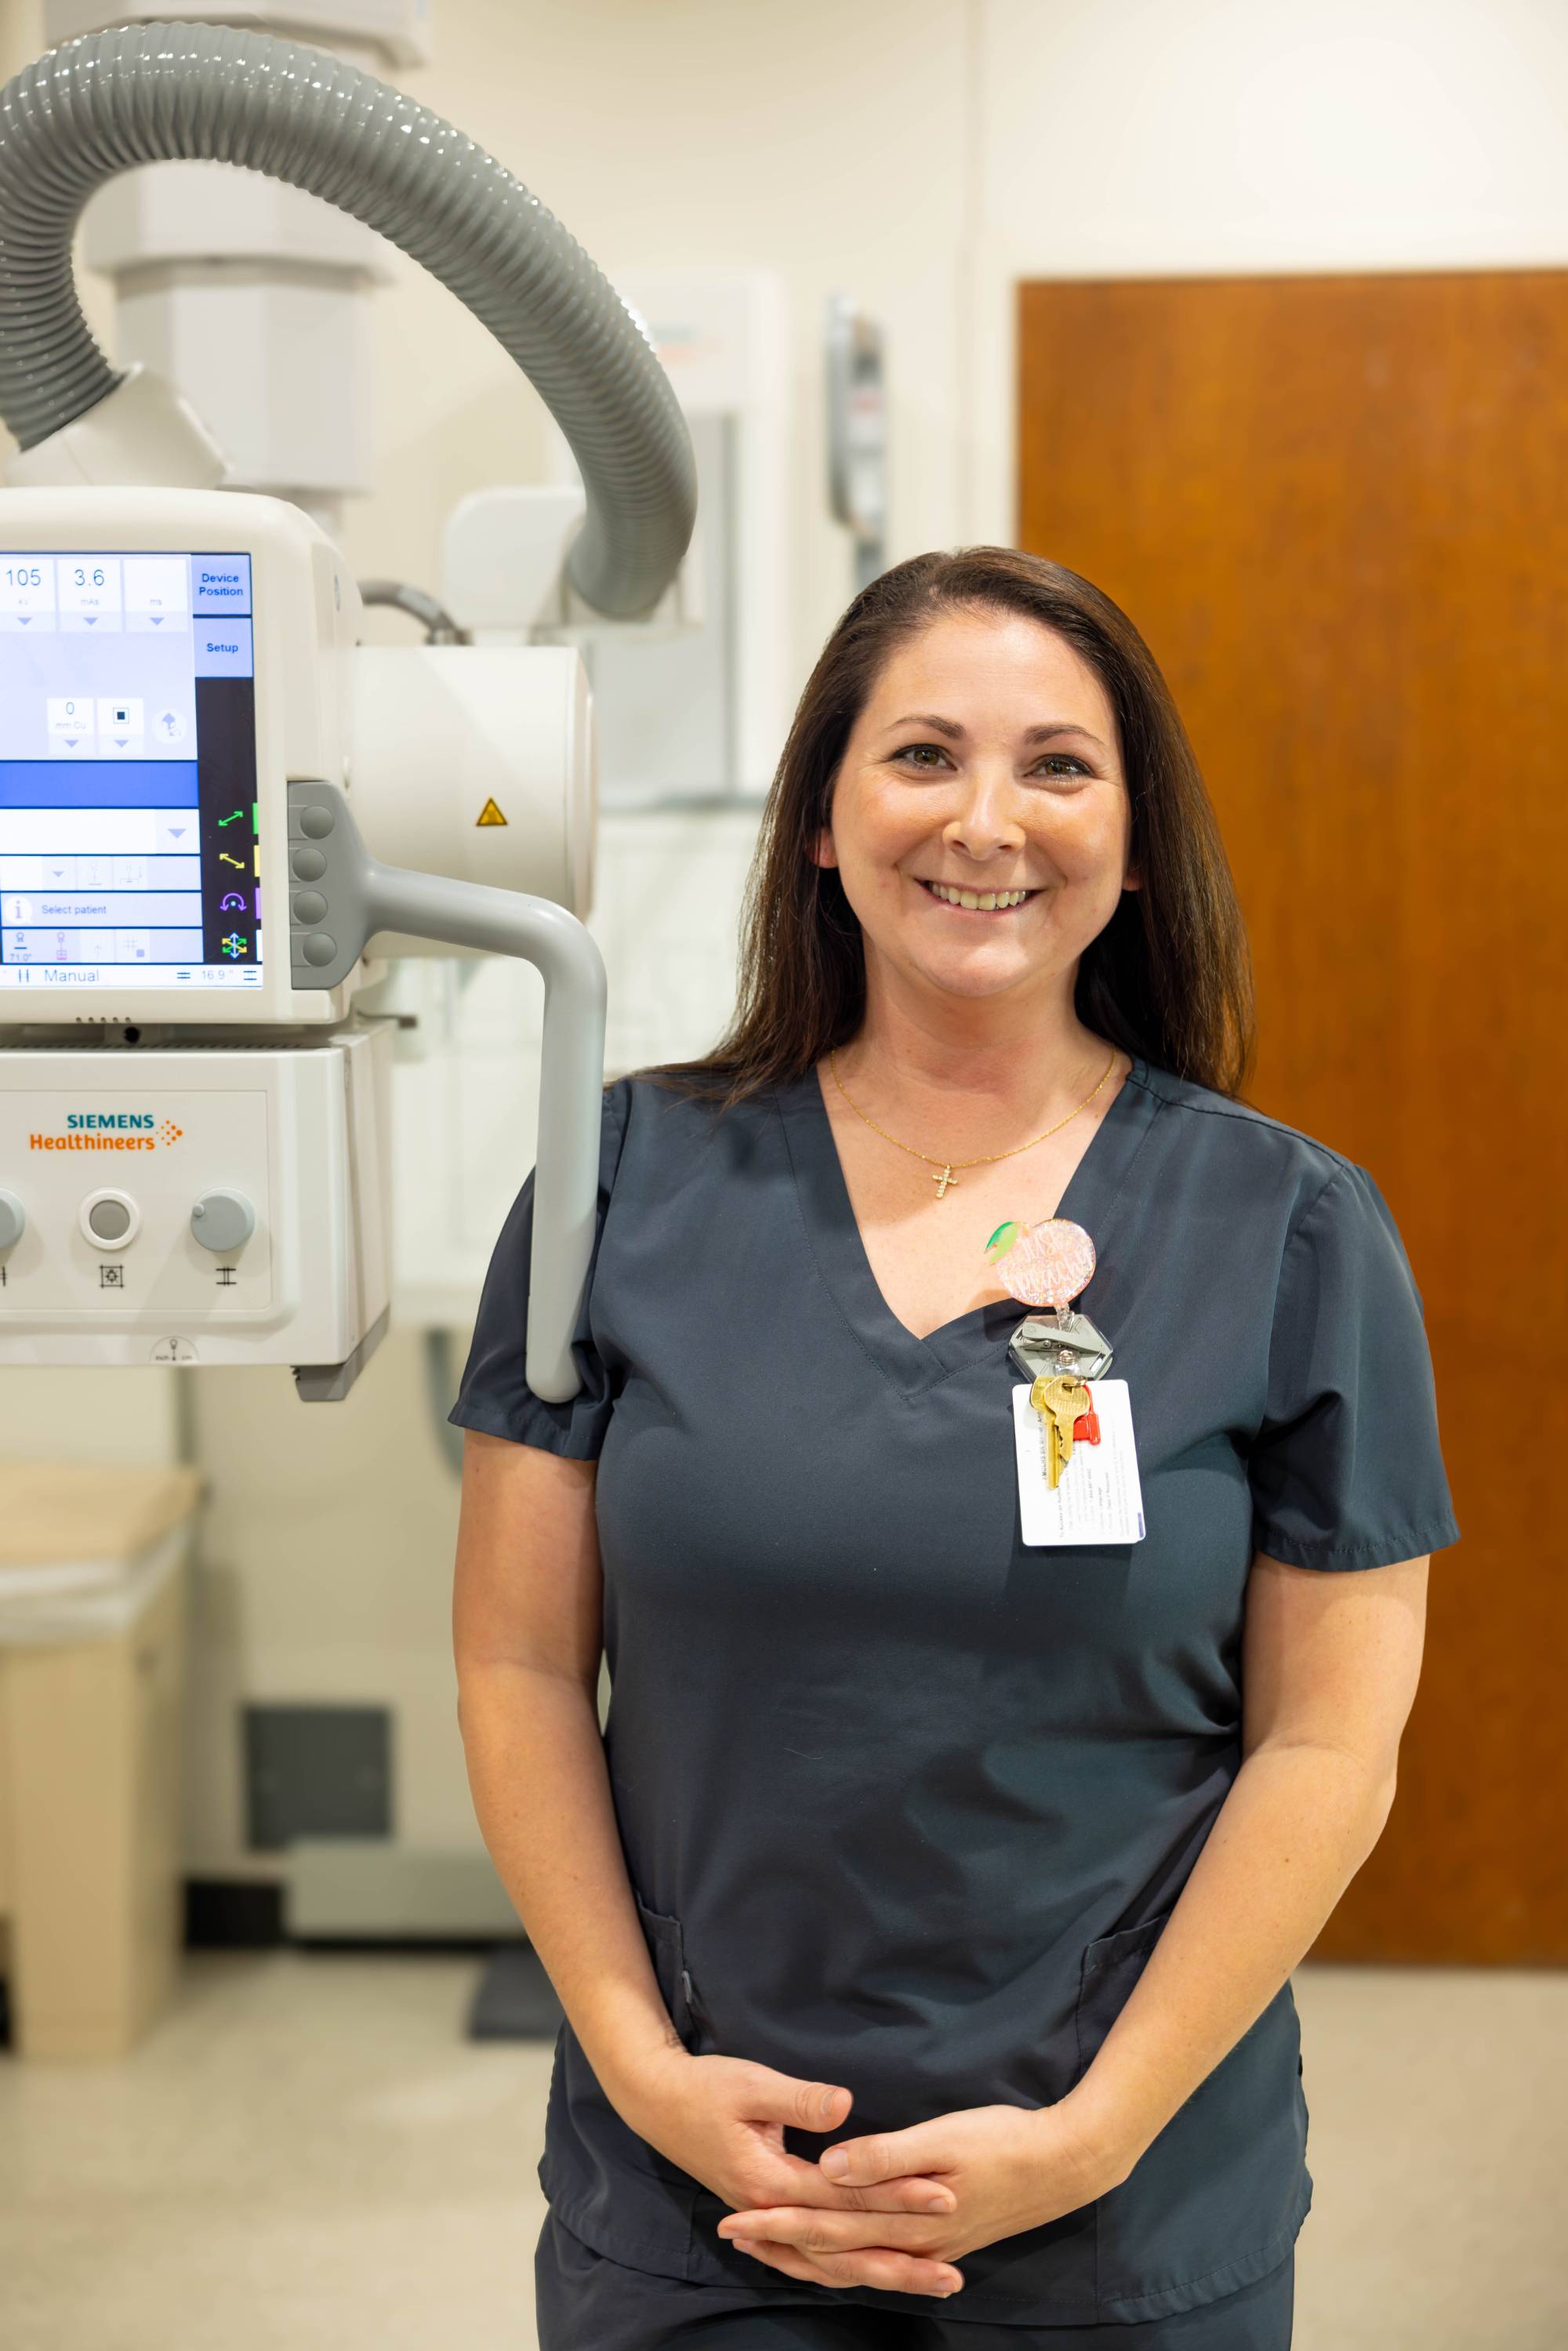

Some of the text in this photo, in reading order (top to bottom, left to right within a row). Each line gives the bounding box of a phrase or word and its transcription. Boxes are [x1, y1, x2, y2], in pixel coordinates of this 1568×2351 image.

[5, 568, 42, 586] 105
[74, 568, 105, 586] 3.6
[201, 573, 239, 582] Device
[198, 586, 244, 597] Position
[206, 643, 238, 654] Setup
[65, 702, 75, 715] 0
[42, 905, 107, 916] Select patient
[44, 969, 100, 982] Manual
[67, 1114, 154, 1129] SIEMENS
[30, 1132, 155, 1150] Healthineers
